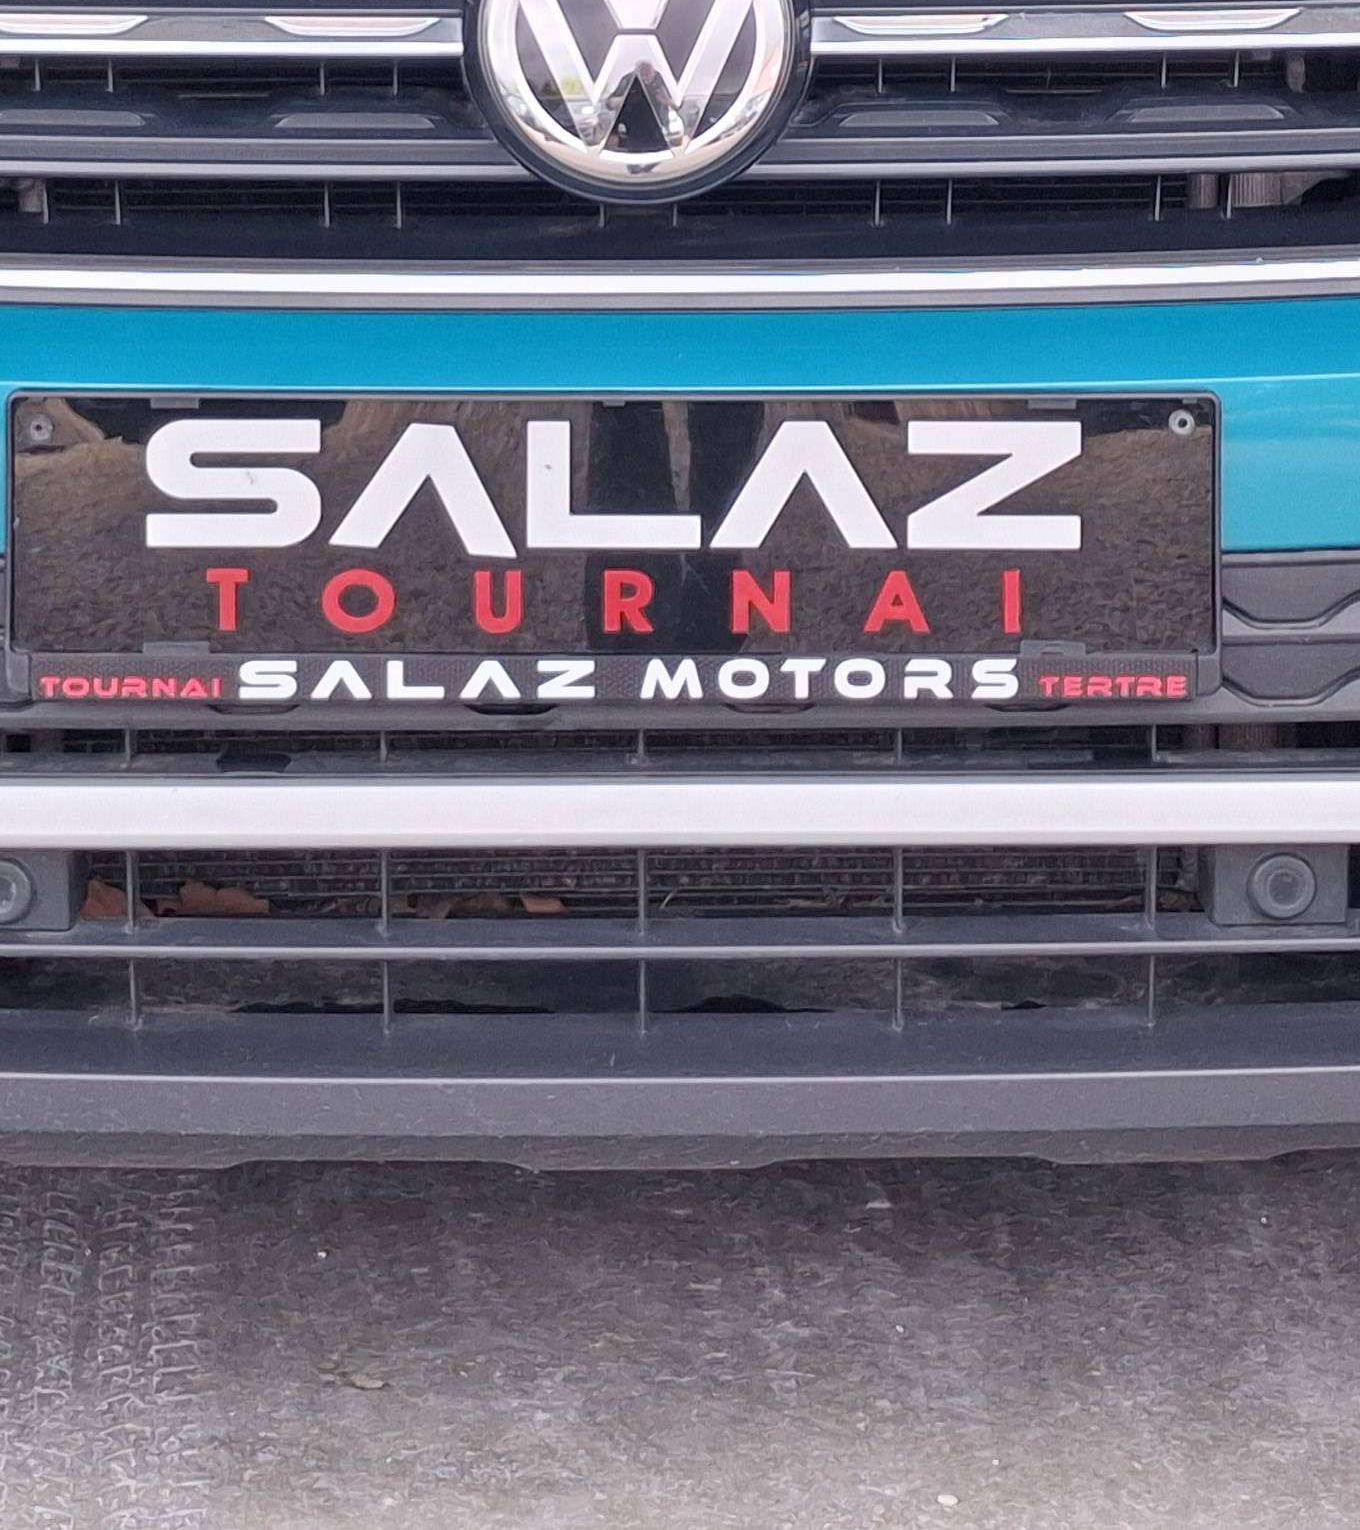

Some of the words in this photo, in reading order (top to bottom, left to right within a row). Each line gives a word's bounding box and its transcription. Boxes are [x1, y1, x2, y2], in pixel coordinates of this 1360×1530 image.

[145, 418, 1082, 558] SALAZ
[206, 568, 1023, 635] TOURNAI
[40, 676, 224, 699] TOURNAI
[239, 660, 596, 700] SALAZ
[639, 657, 1020, 700] MOTORS
[1040, 674, 1188, 698] TERTRE
